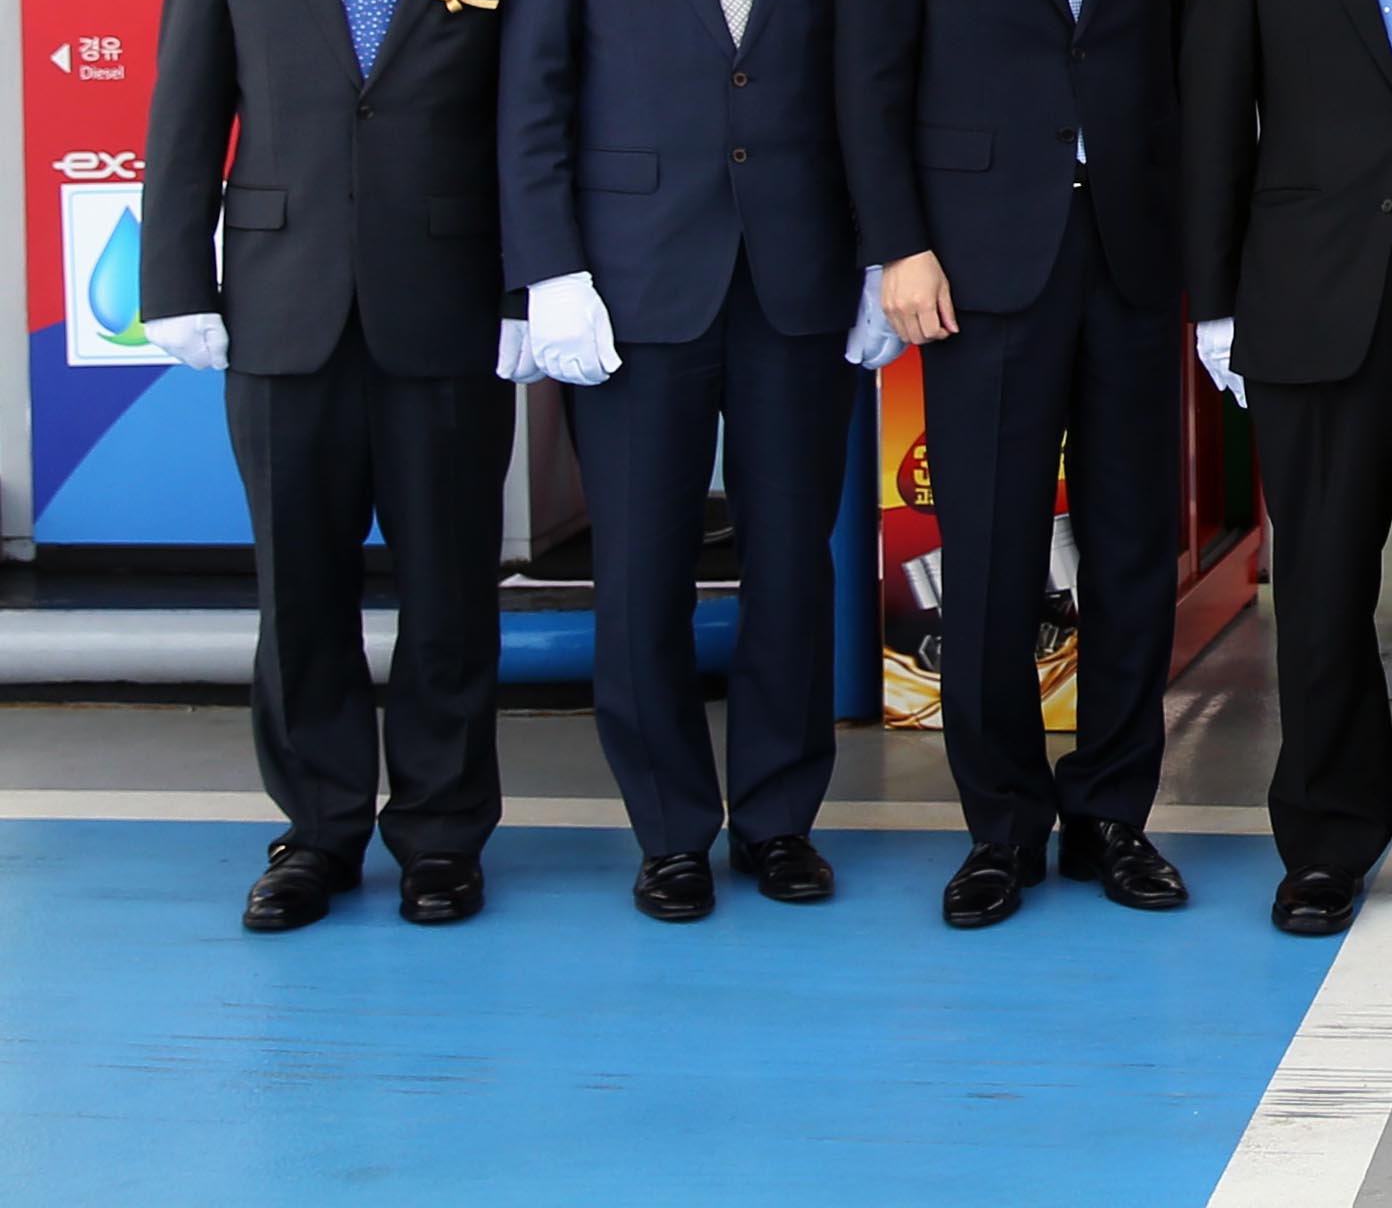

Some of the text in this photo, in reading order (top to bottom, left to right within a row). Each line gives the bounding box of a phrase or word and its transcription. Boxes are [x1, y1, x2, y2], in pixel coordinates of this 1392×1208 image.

[78, 36, 123, 62] 경유
[80, 65, 125, 81] Diesel
[52, 151, 146, 180] ex-
